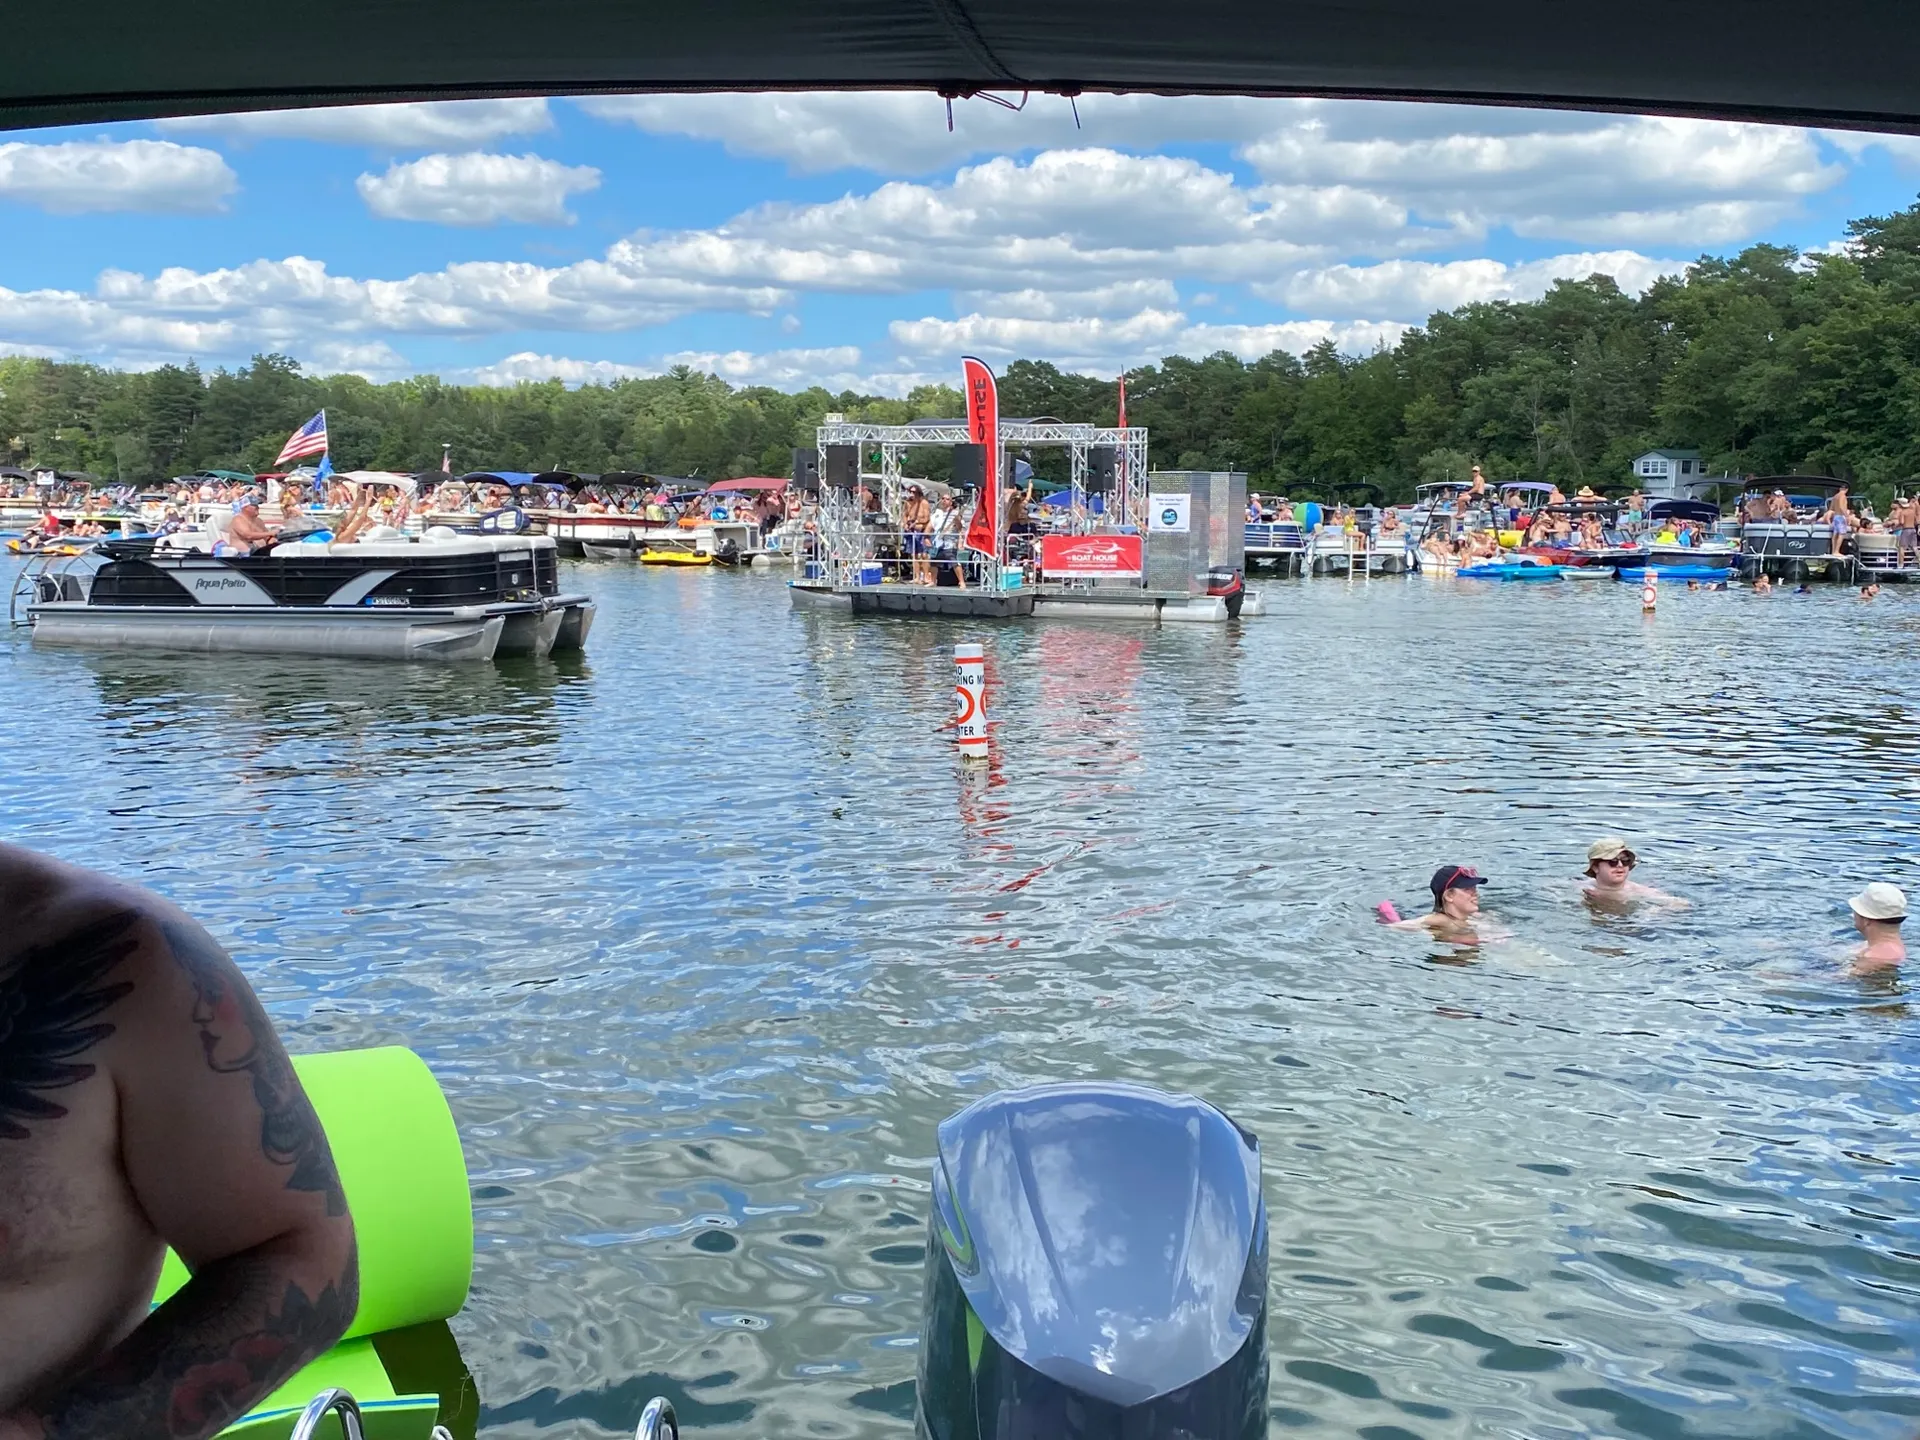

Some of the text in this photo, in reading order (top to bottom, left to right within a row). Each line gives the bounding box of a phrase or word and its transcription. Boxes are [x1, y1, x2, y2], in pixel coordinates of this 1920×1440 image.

[1071, 554, 1091, 562] BOAT
[1092, 554, 1118, 562] HOUSE
[195, 578, 247, 590] Aqua Patio
[958, 726, 974, 736] TER
